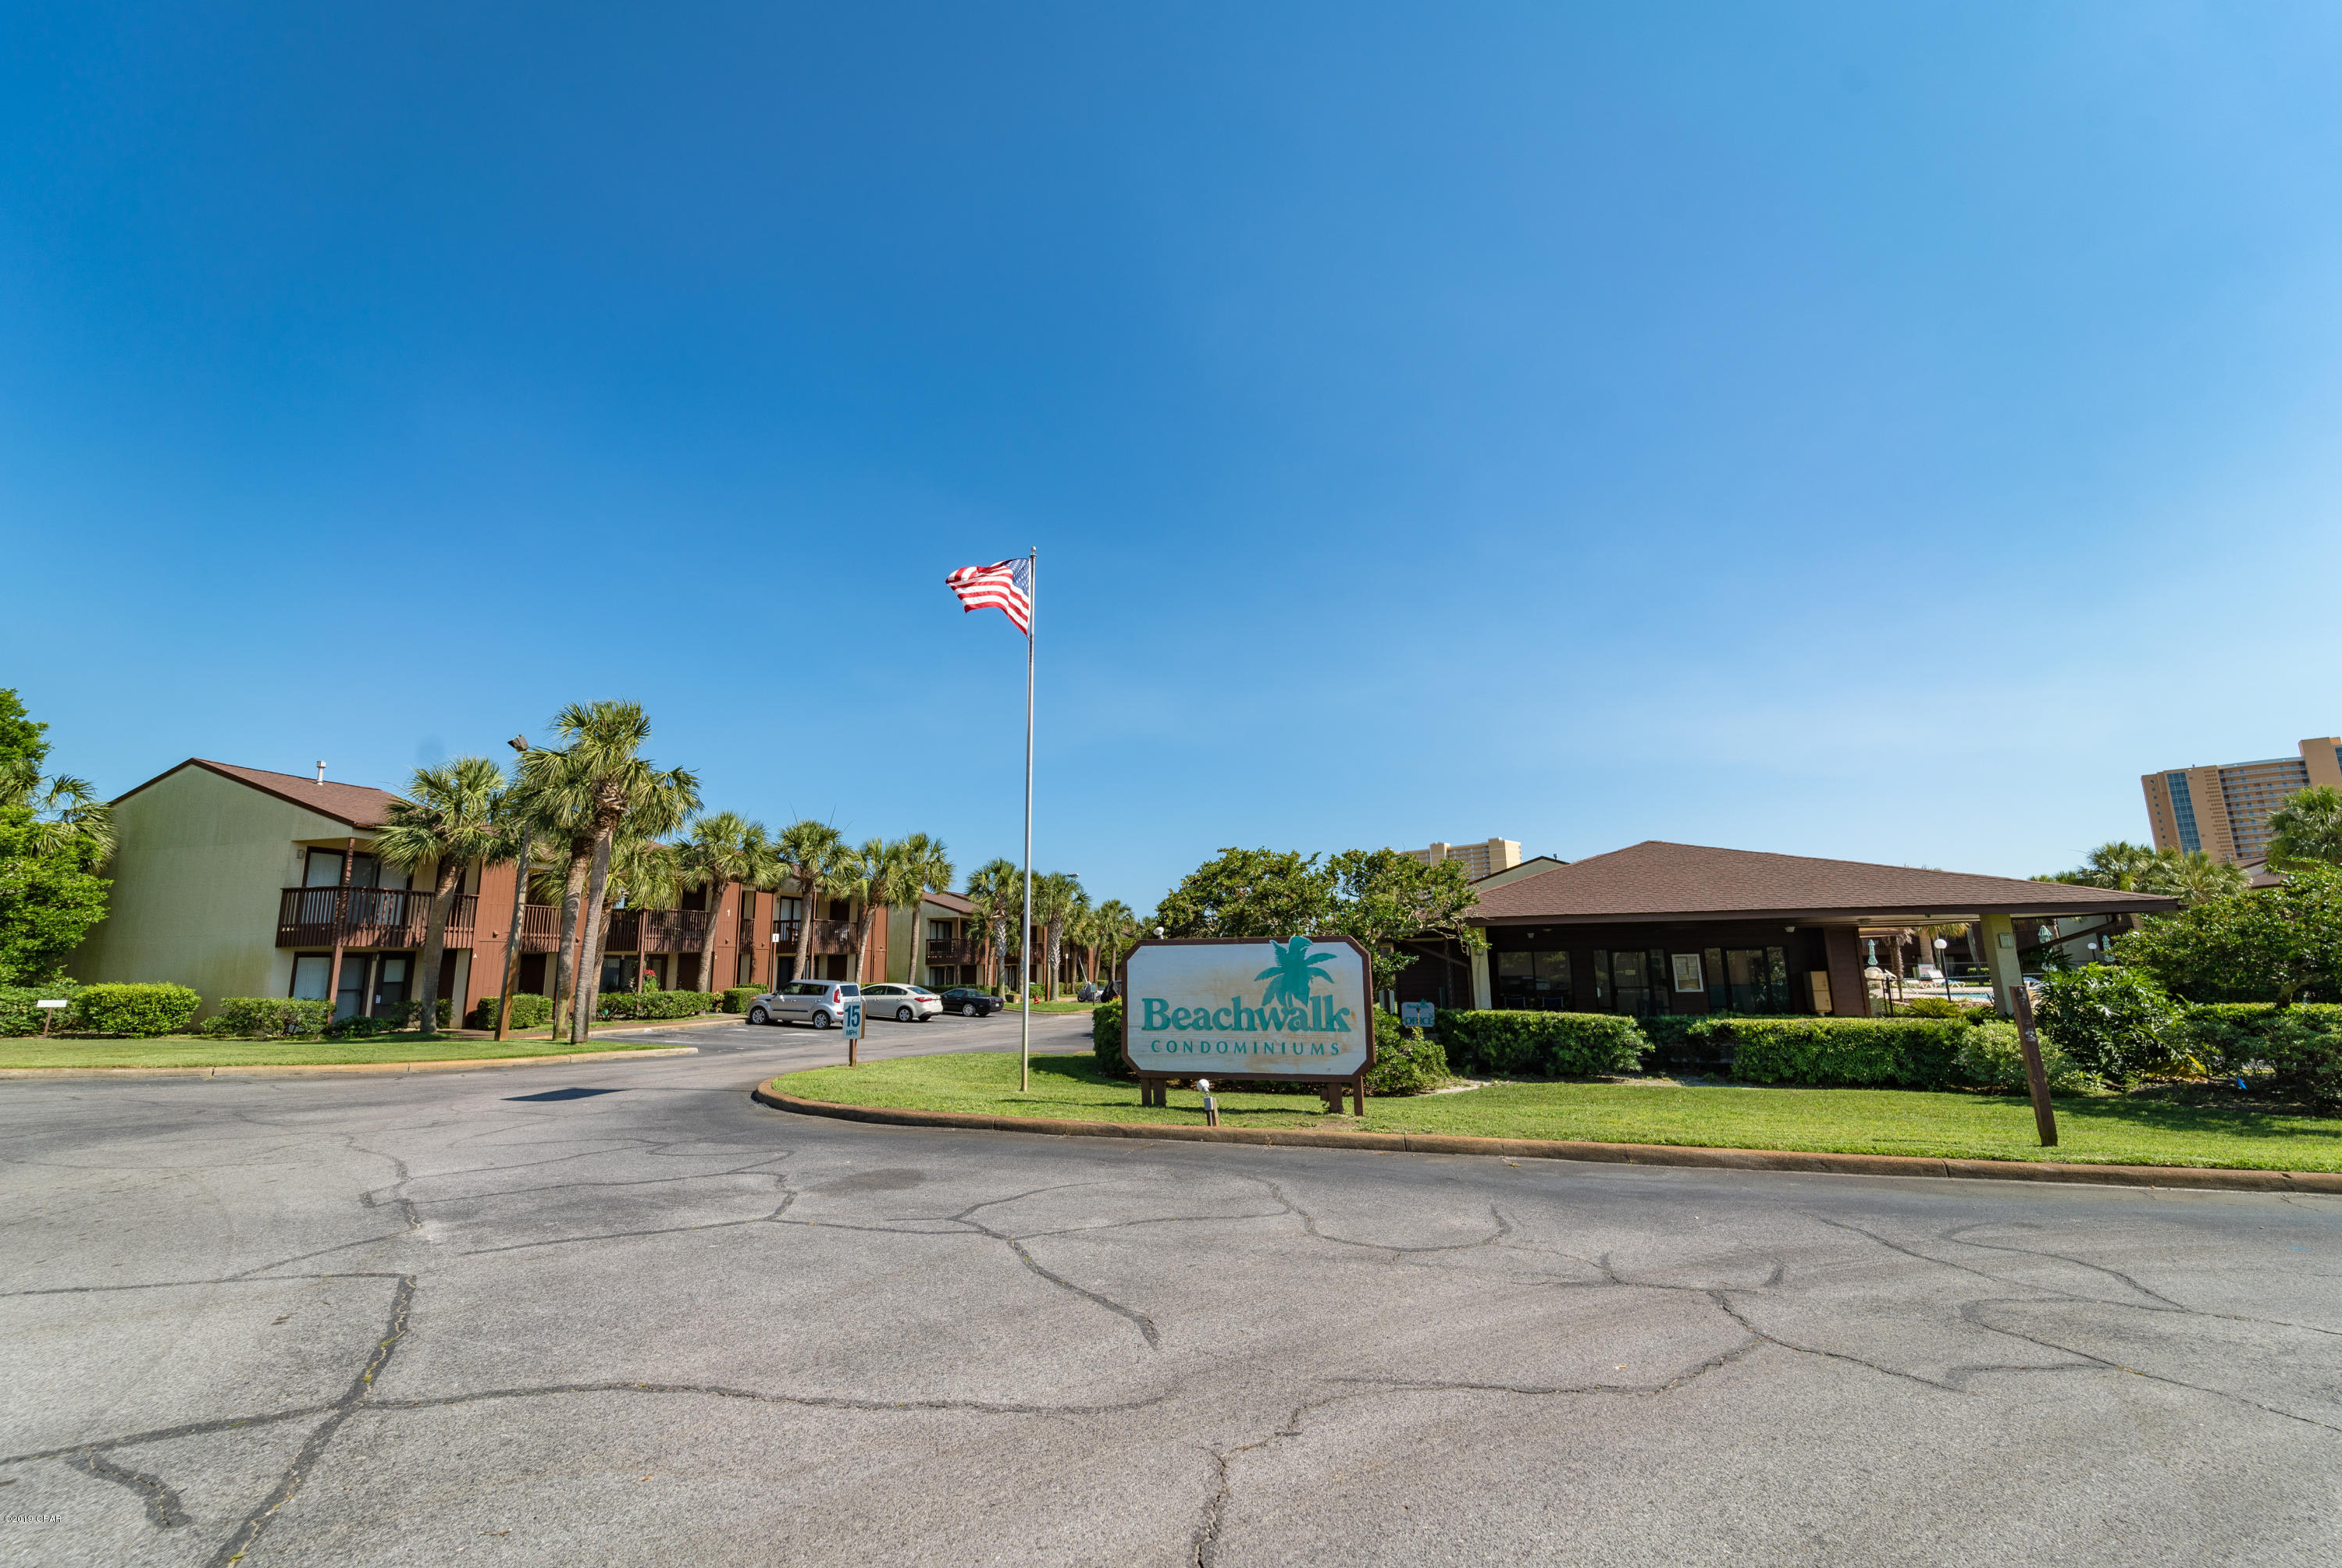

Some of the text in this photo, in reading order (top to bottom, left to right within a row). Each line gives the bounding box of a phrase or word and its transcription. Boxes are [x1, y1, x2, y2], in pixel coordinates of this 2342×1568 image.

[726, 908, 731, 918] 1
[845, 1004, 861, 1028] 15
[1141, 995, 1351, 1033] Beachwalk
[1151, 1040, 1341, 1055] CONDOMINIUMS
